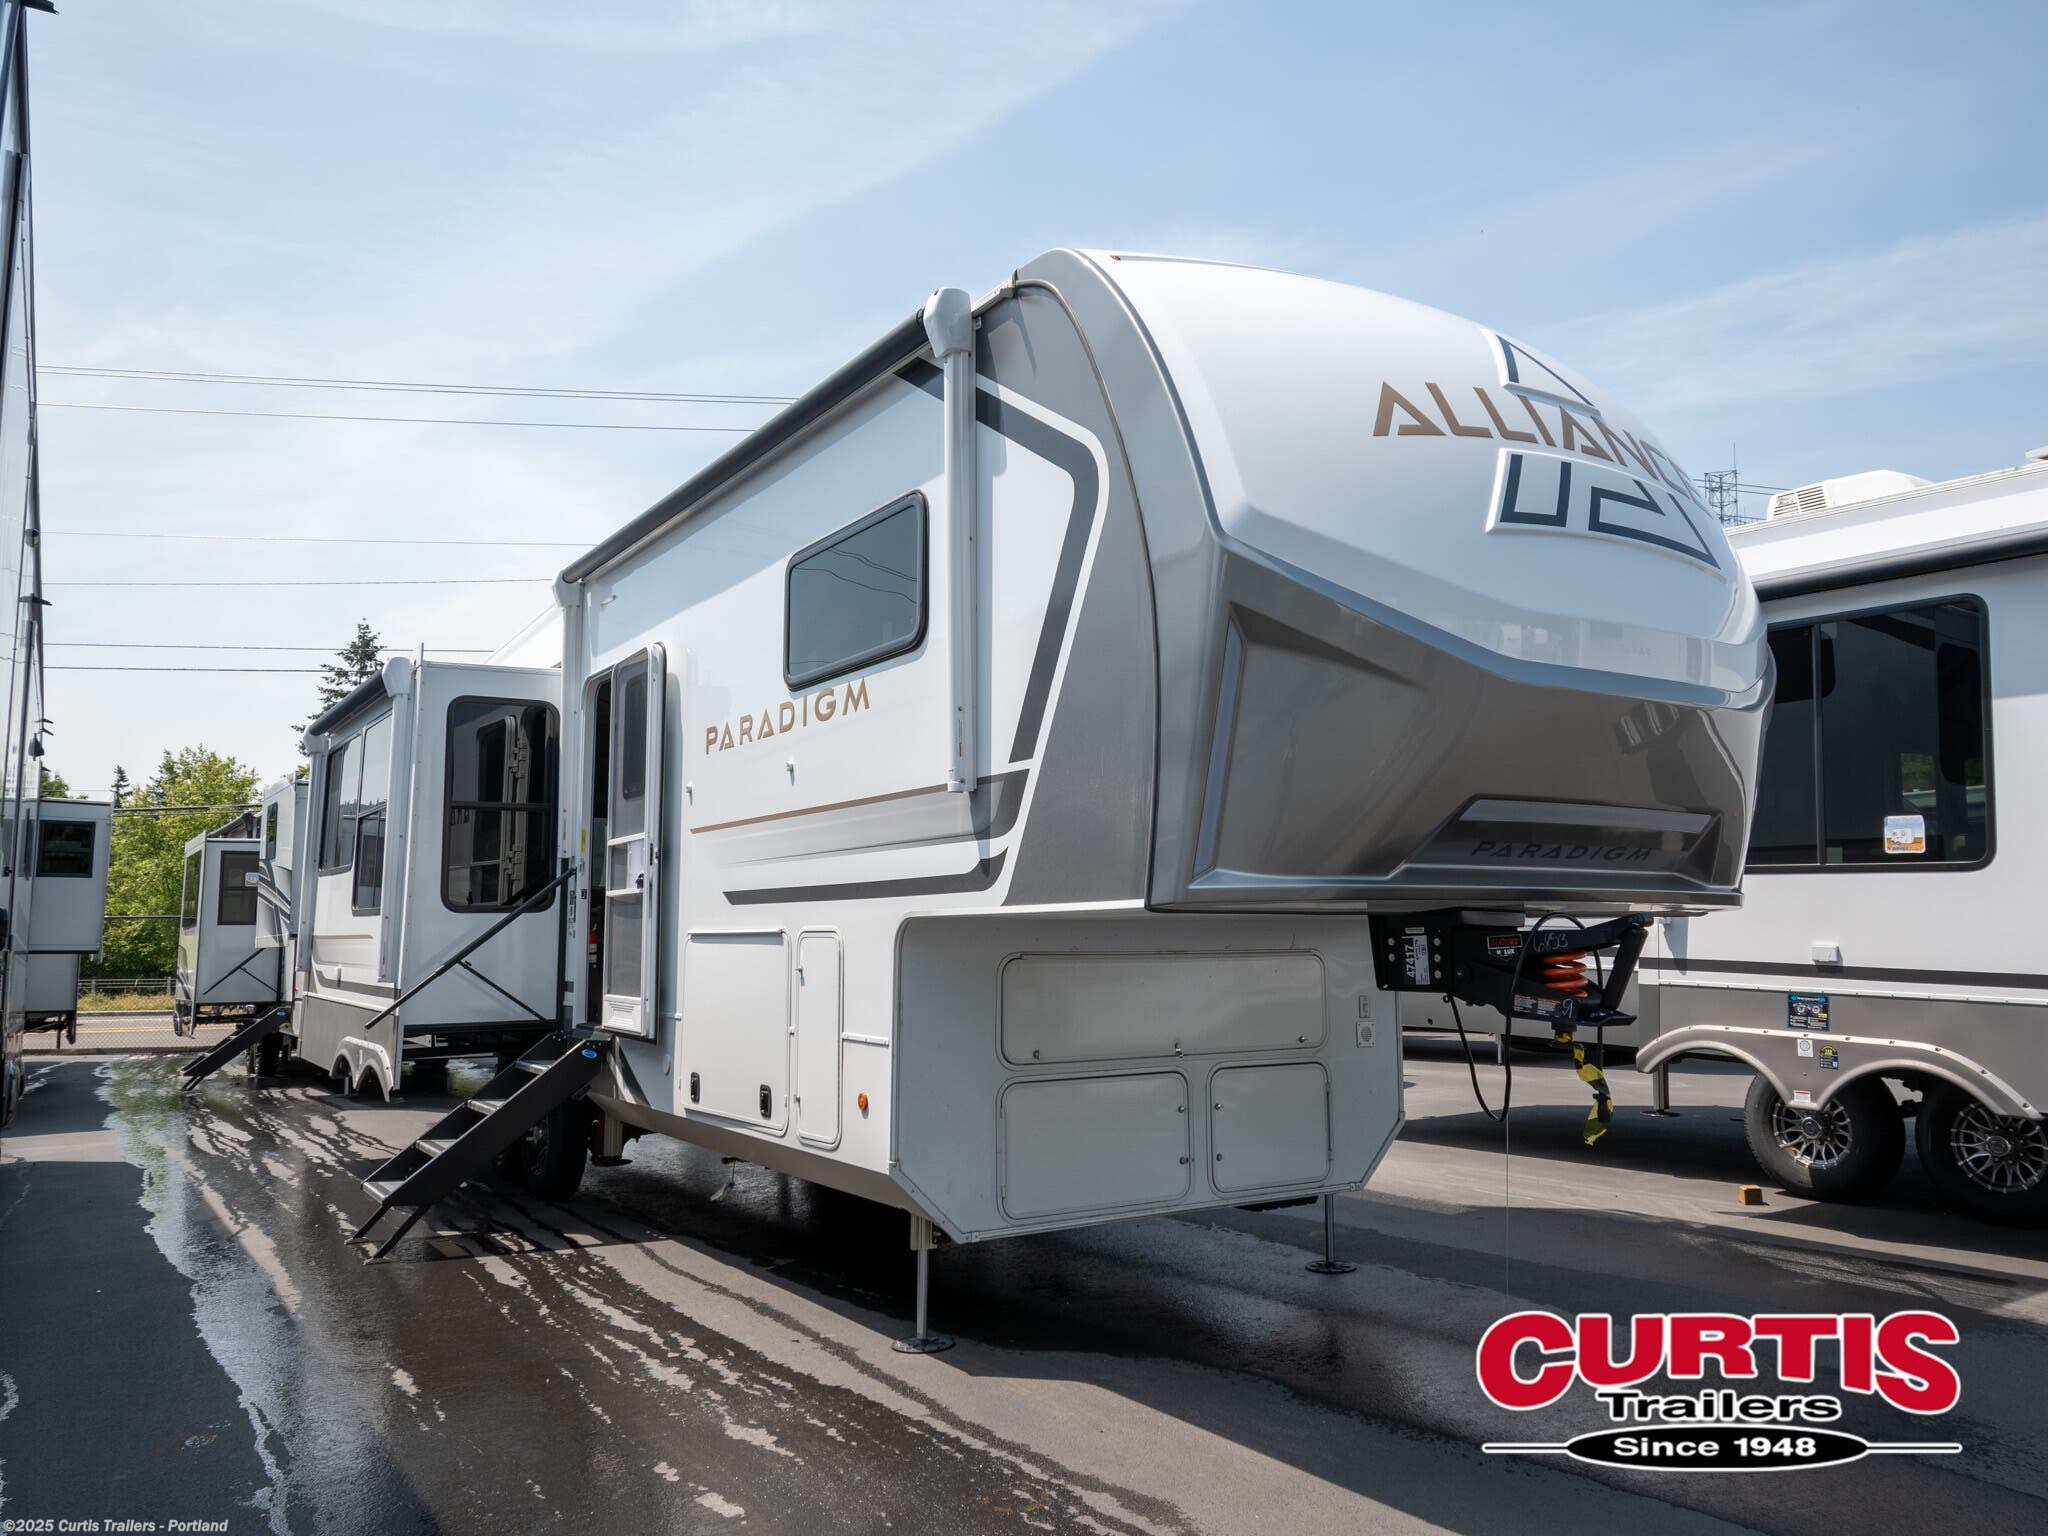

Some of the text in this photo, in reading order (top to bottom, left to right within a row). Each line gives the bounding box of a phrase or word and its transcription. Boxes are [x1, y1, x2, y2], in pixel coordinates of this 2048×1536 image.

[706, 676, 870, 755] PARADIGM
[1470, 841, 1653, 862] PARADIGM
[1404, 944, 1416, 978] 47417
